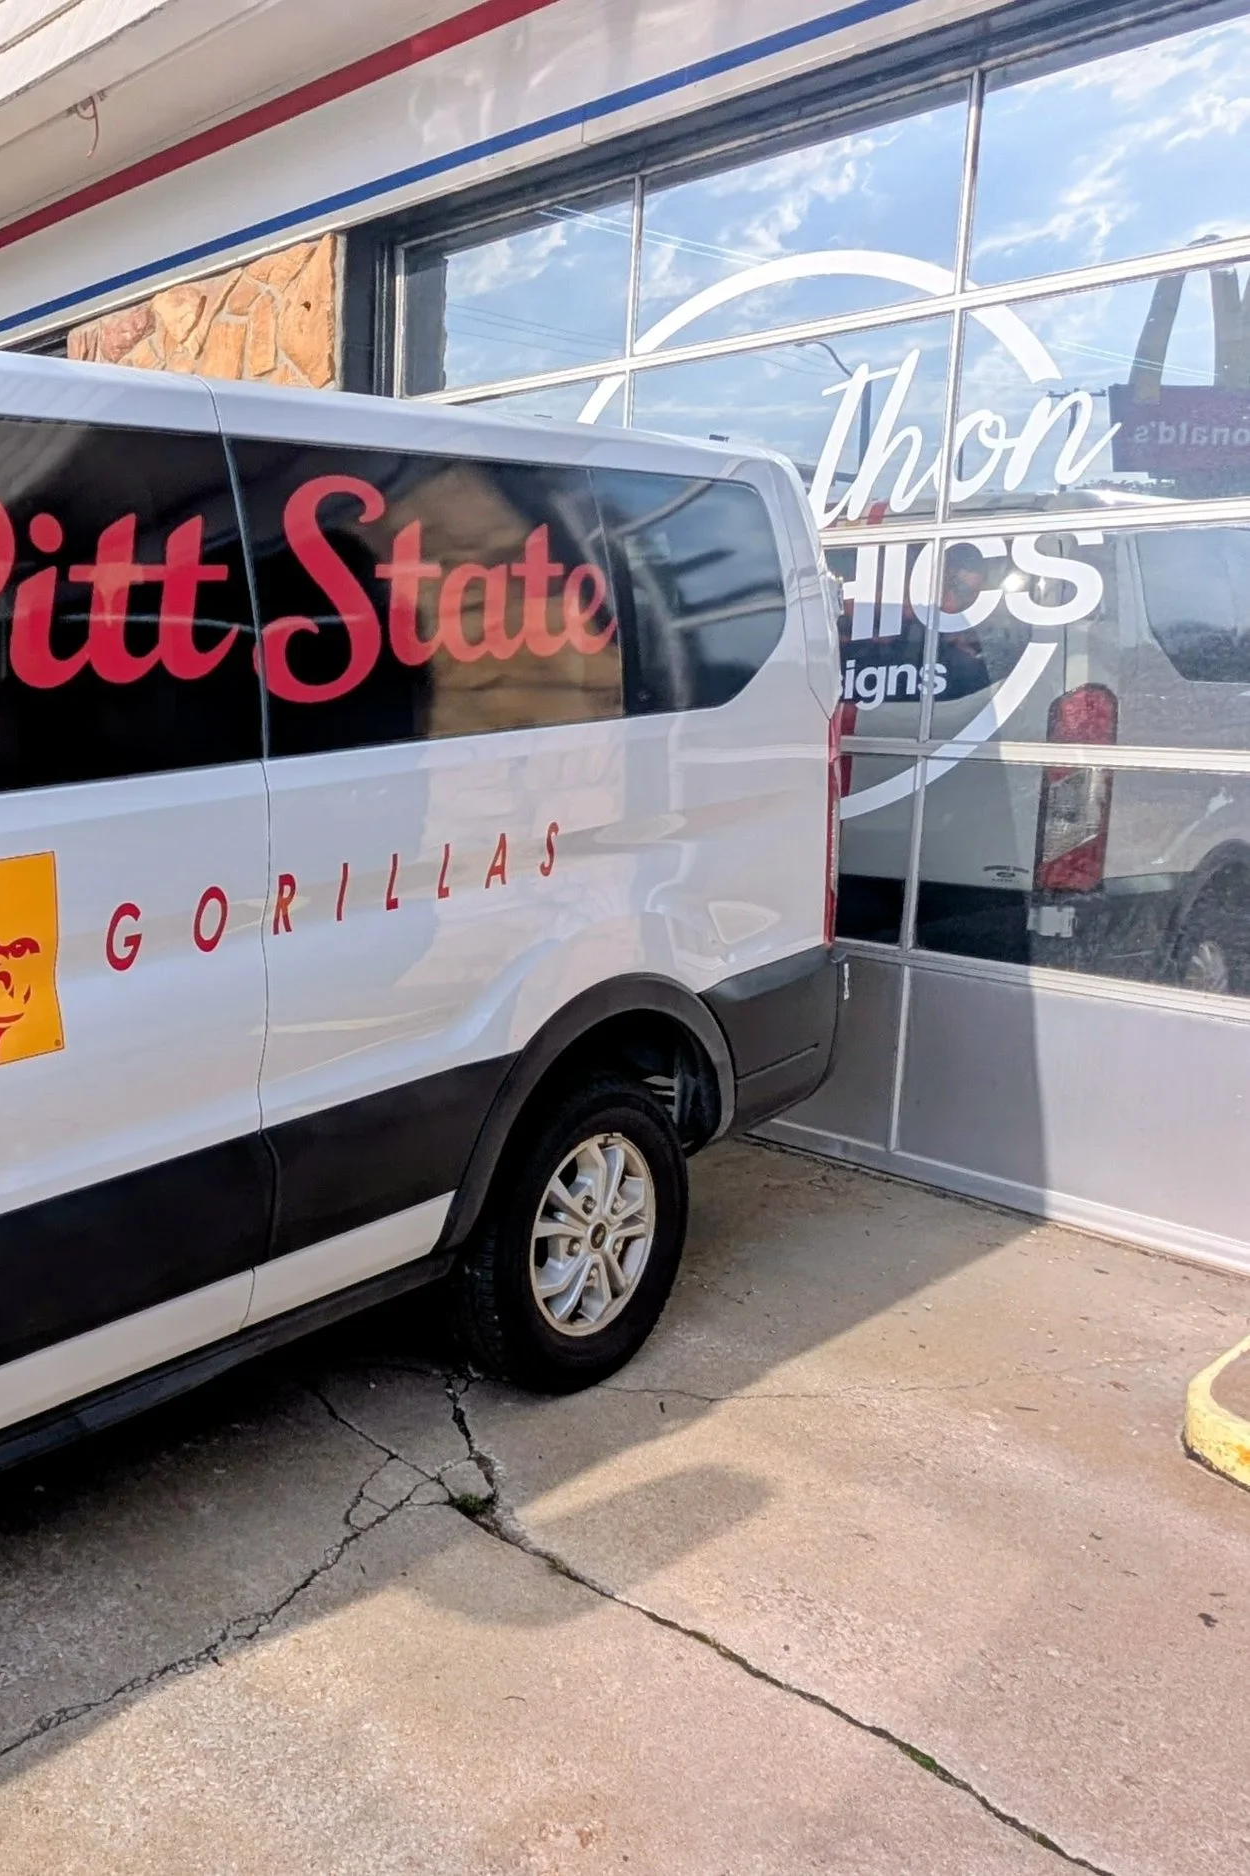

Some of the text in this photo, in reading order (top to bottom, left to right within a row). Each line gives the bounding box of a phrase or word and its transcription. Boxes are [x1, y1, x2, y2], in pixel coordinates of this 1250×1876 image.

[253, 475, 618, 703] State
[840, 659, 947, 711] igns
[106, 821, 559, 971] GORILLAS
